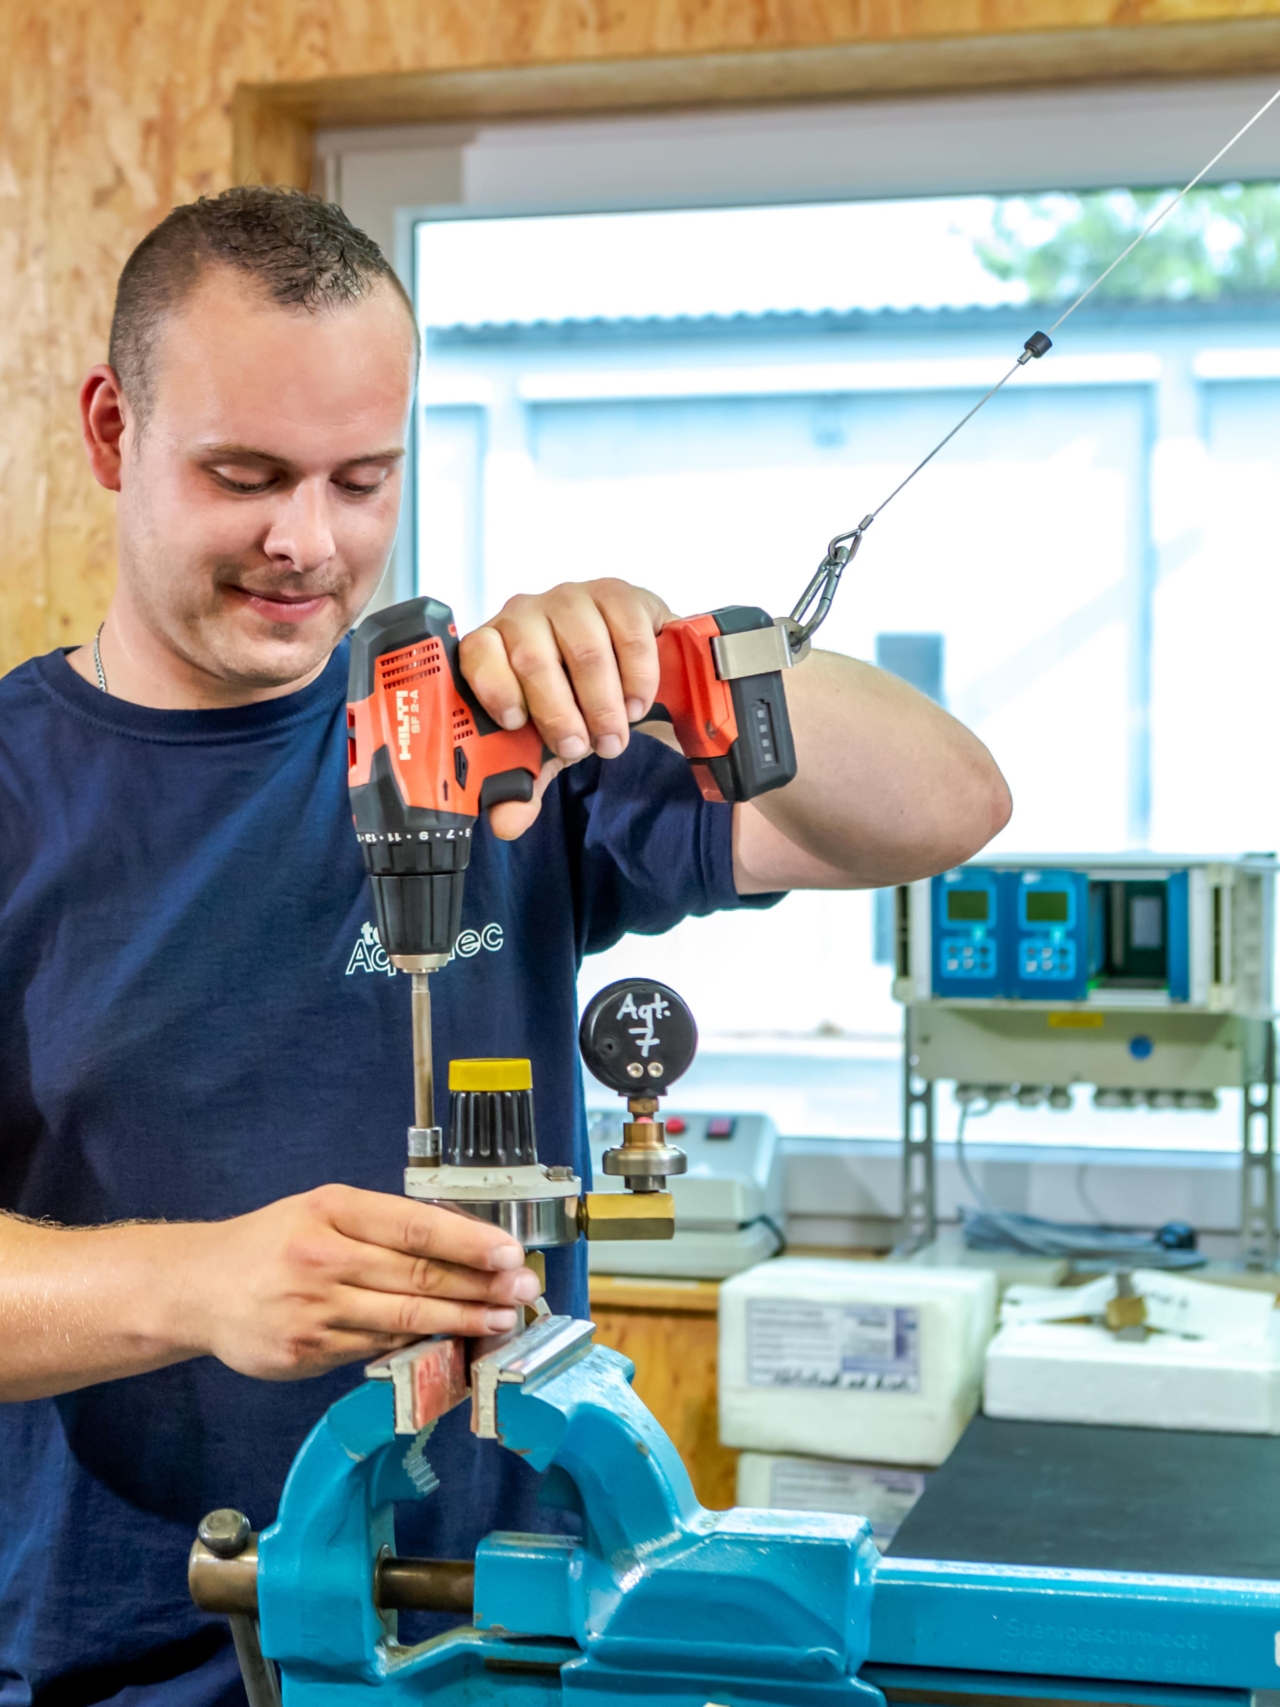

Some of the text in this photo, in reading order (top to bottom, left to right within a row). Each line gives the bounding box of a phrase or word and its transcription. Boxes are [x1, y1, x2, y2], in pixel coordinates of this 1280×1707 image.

[410, 689, 421, 734] SF 2-A
[396, 690, 411, 760] HILTI
[365, 833, 377, 842] 13
[387, 832, 402, 842] 11
[419, 831, 429, 840] 9
[446, 829, 455, 838] 7
[628, 1027, 660, 1058] 7
